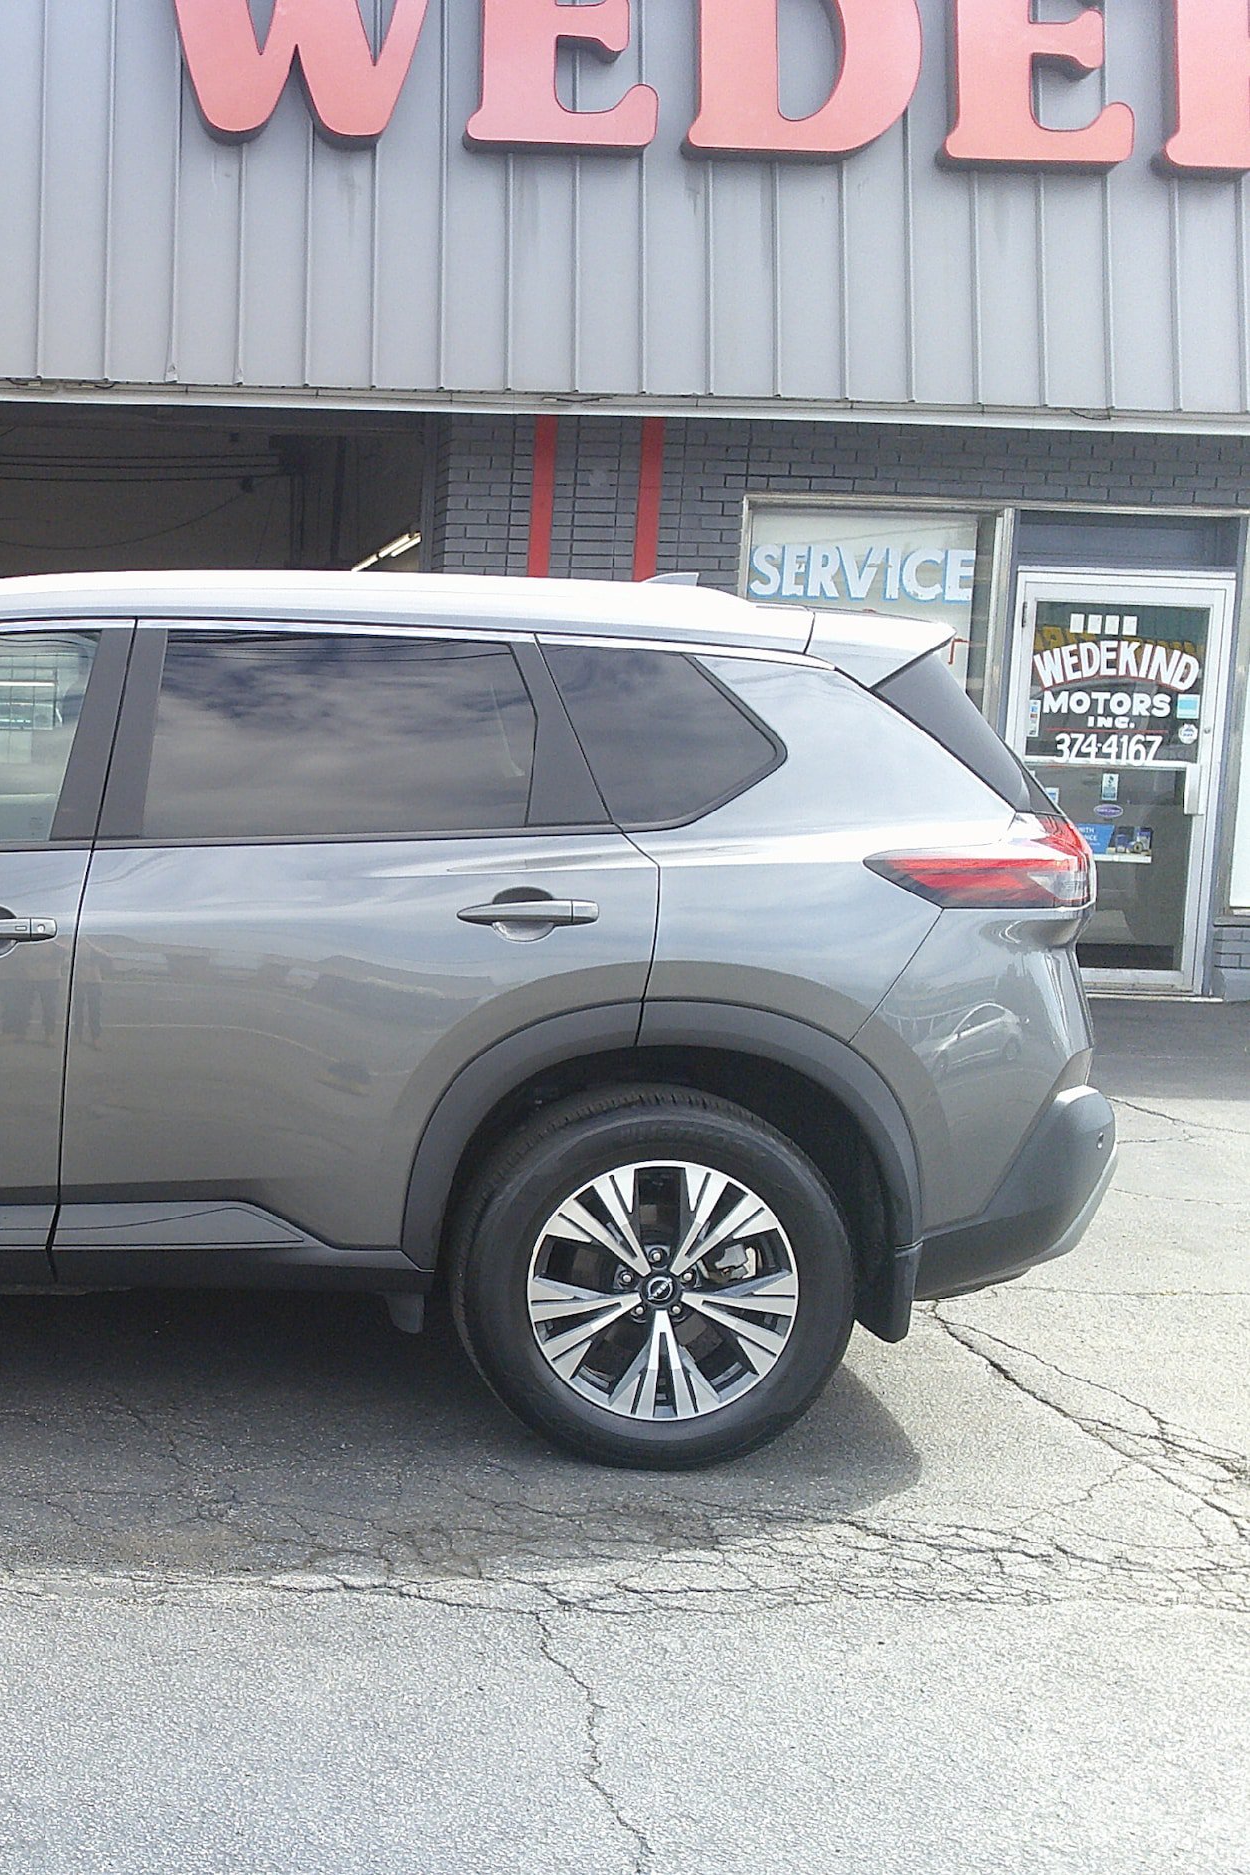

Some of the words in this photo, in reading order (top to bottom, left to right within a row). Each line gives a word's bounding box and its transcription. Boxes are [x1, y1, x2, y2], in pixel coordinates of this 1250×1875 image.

[180, 0, 1250, 172] WEDE
[749, 544, 977, 602] SERVICE
[1033, 640, 1200, 692] WEDEKIND
[1042, 690, 1172, 718] MOTORS
[1086, 715, 1136, 729] INC.
[1054, 732, 1164, 767] 374-4167
